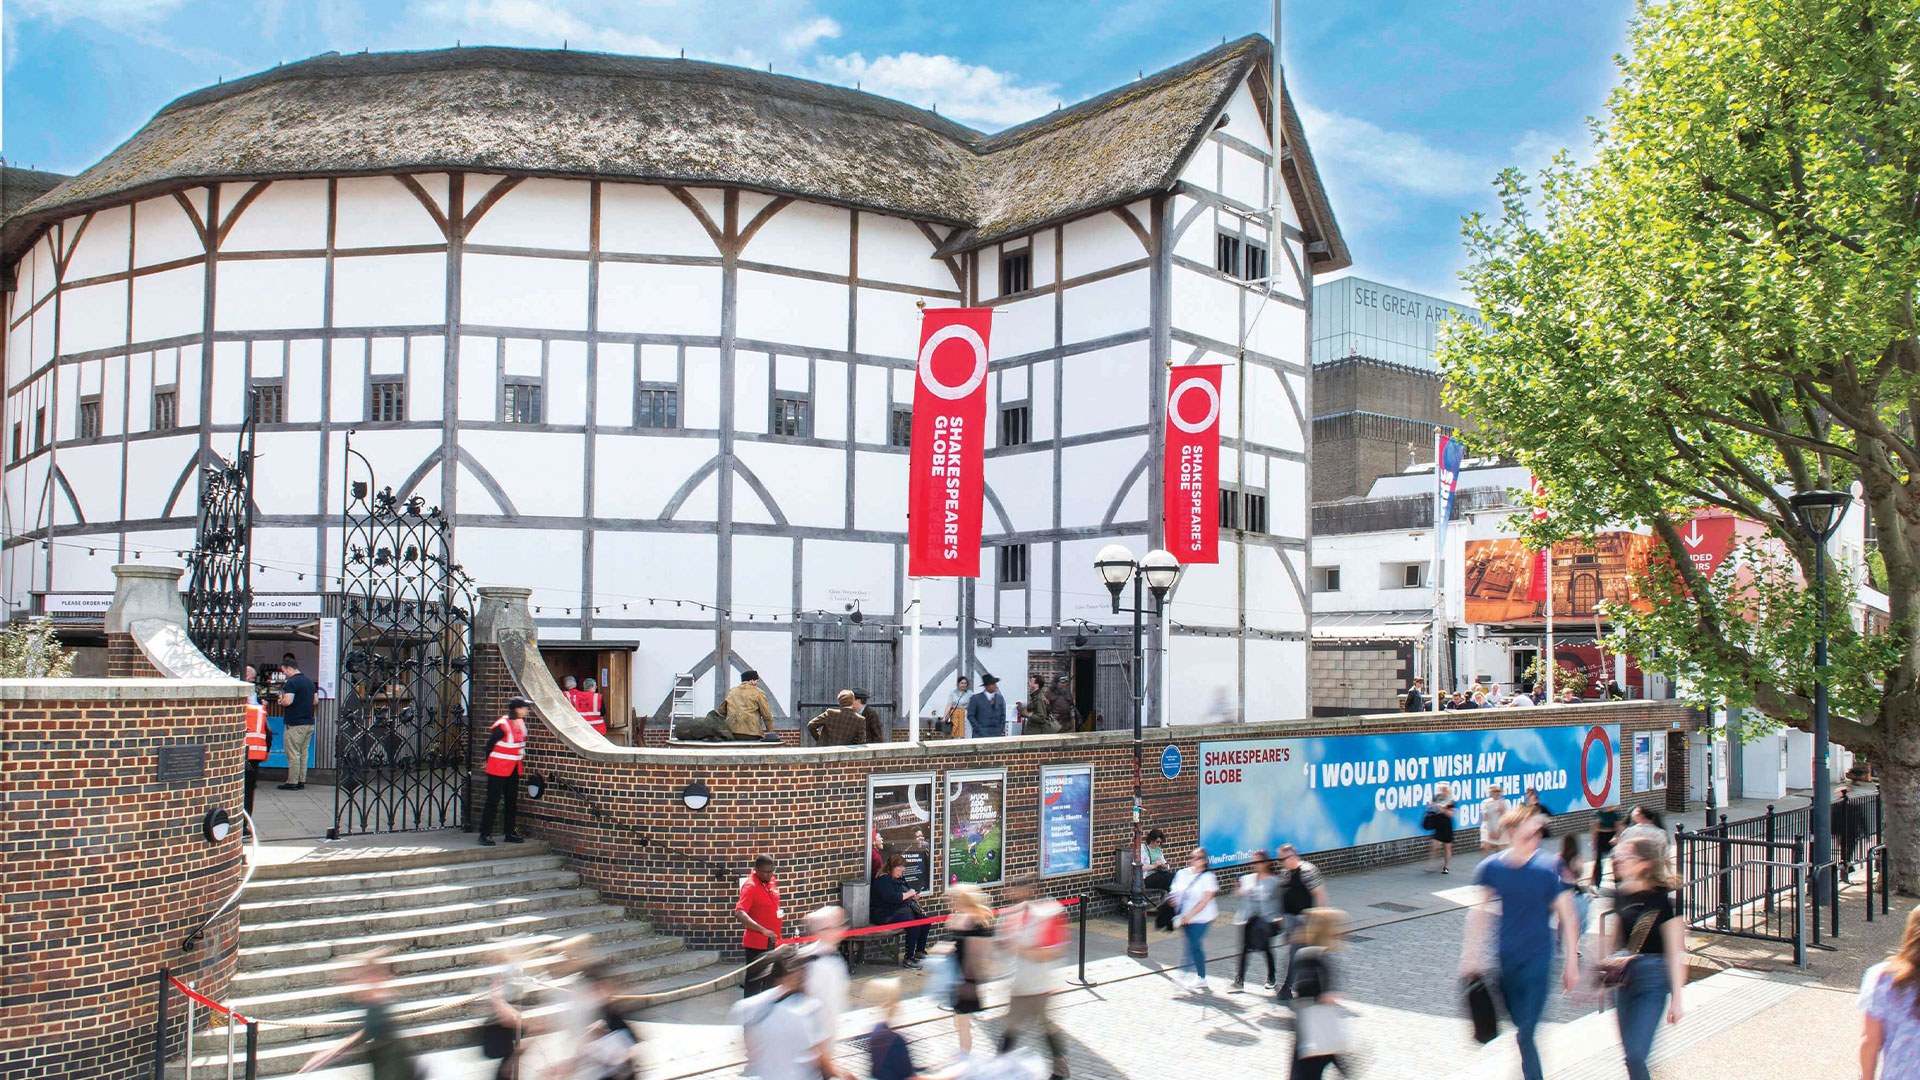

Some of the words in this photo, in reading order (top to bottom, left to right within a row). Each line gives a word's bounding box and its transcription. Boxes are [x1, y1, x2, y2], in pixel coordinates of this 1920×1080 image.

[1355, 287, 1377, 308] SEE
[1382, 294, 1421, 319] GREAT
[1425, 305, 1448, 322] ART
[931, 415, 949, 477] GLOBE
[1180, 445, 1191, 490] GLOBE
[943, 415, 963, 560] SHAKESPEARE'S
[1190, 445, 1203, 552] SHAKESPEARE'S
[1689, 553, 1713, 562] IDED
[1205, 747, 1290, 767] SHAKESPEARE'S
[1204, 768, 1242, 786] GLOBE
[1321, 759, 1390, 788] WOULD
[1394, 757, 1430, 782] NOT
[1432, 753, 1473, 778] WISH
[1475, 751, 1507, 774] ANY
[1045, 777, 1074, 787] SUMMER
[1045, 786, 1063, 794] 2022
[1374, 780, 1472, 812] COMPAON
[1475, 777, 1490, 799] IN
[1523, 769, 1568, 795] WORLD
[970, 793, 989, 801] MUCH
[970, 805, 993, 813] ABOUT
[970, 811, 998, 820] NOTHING
